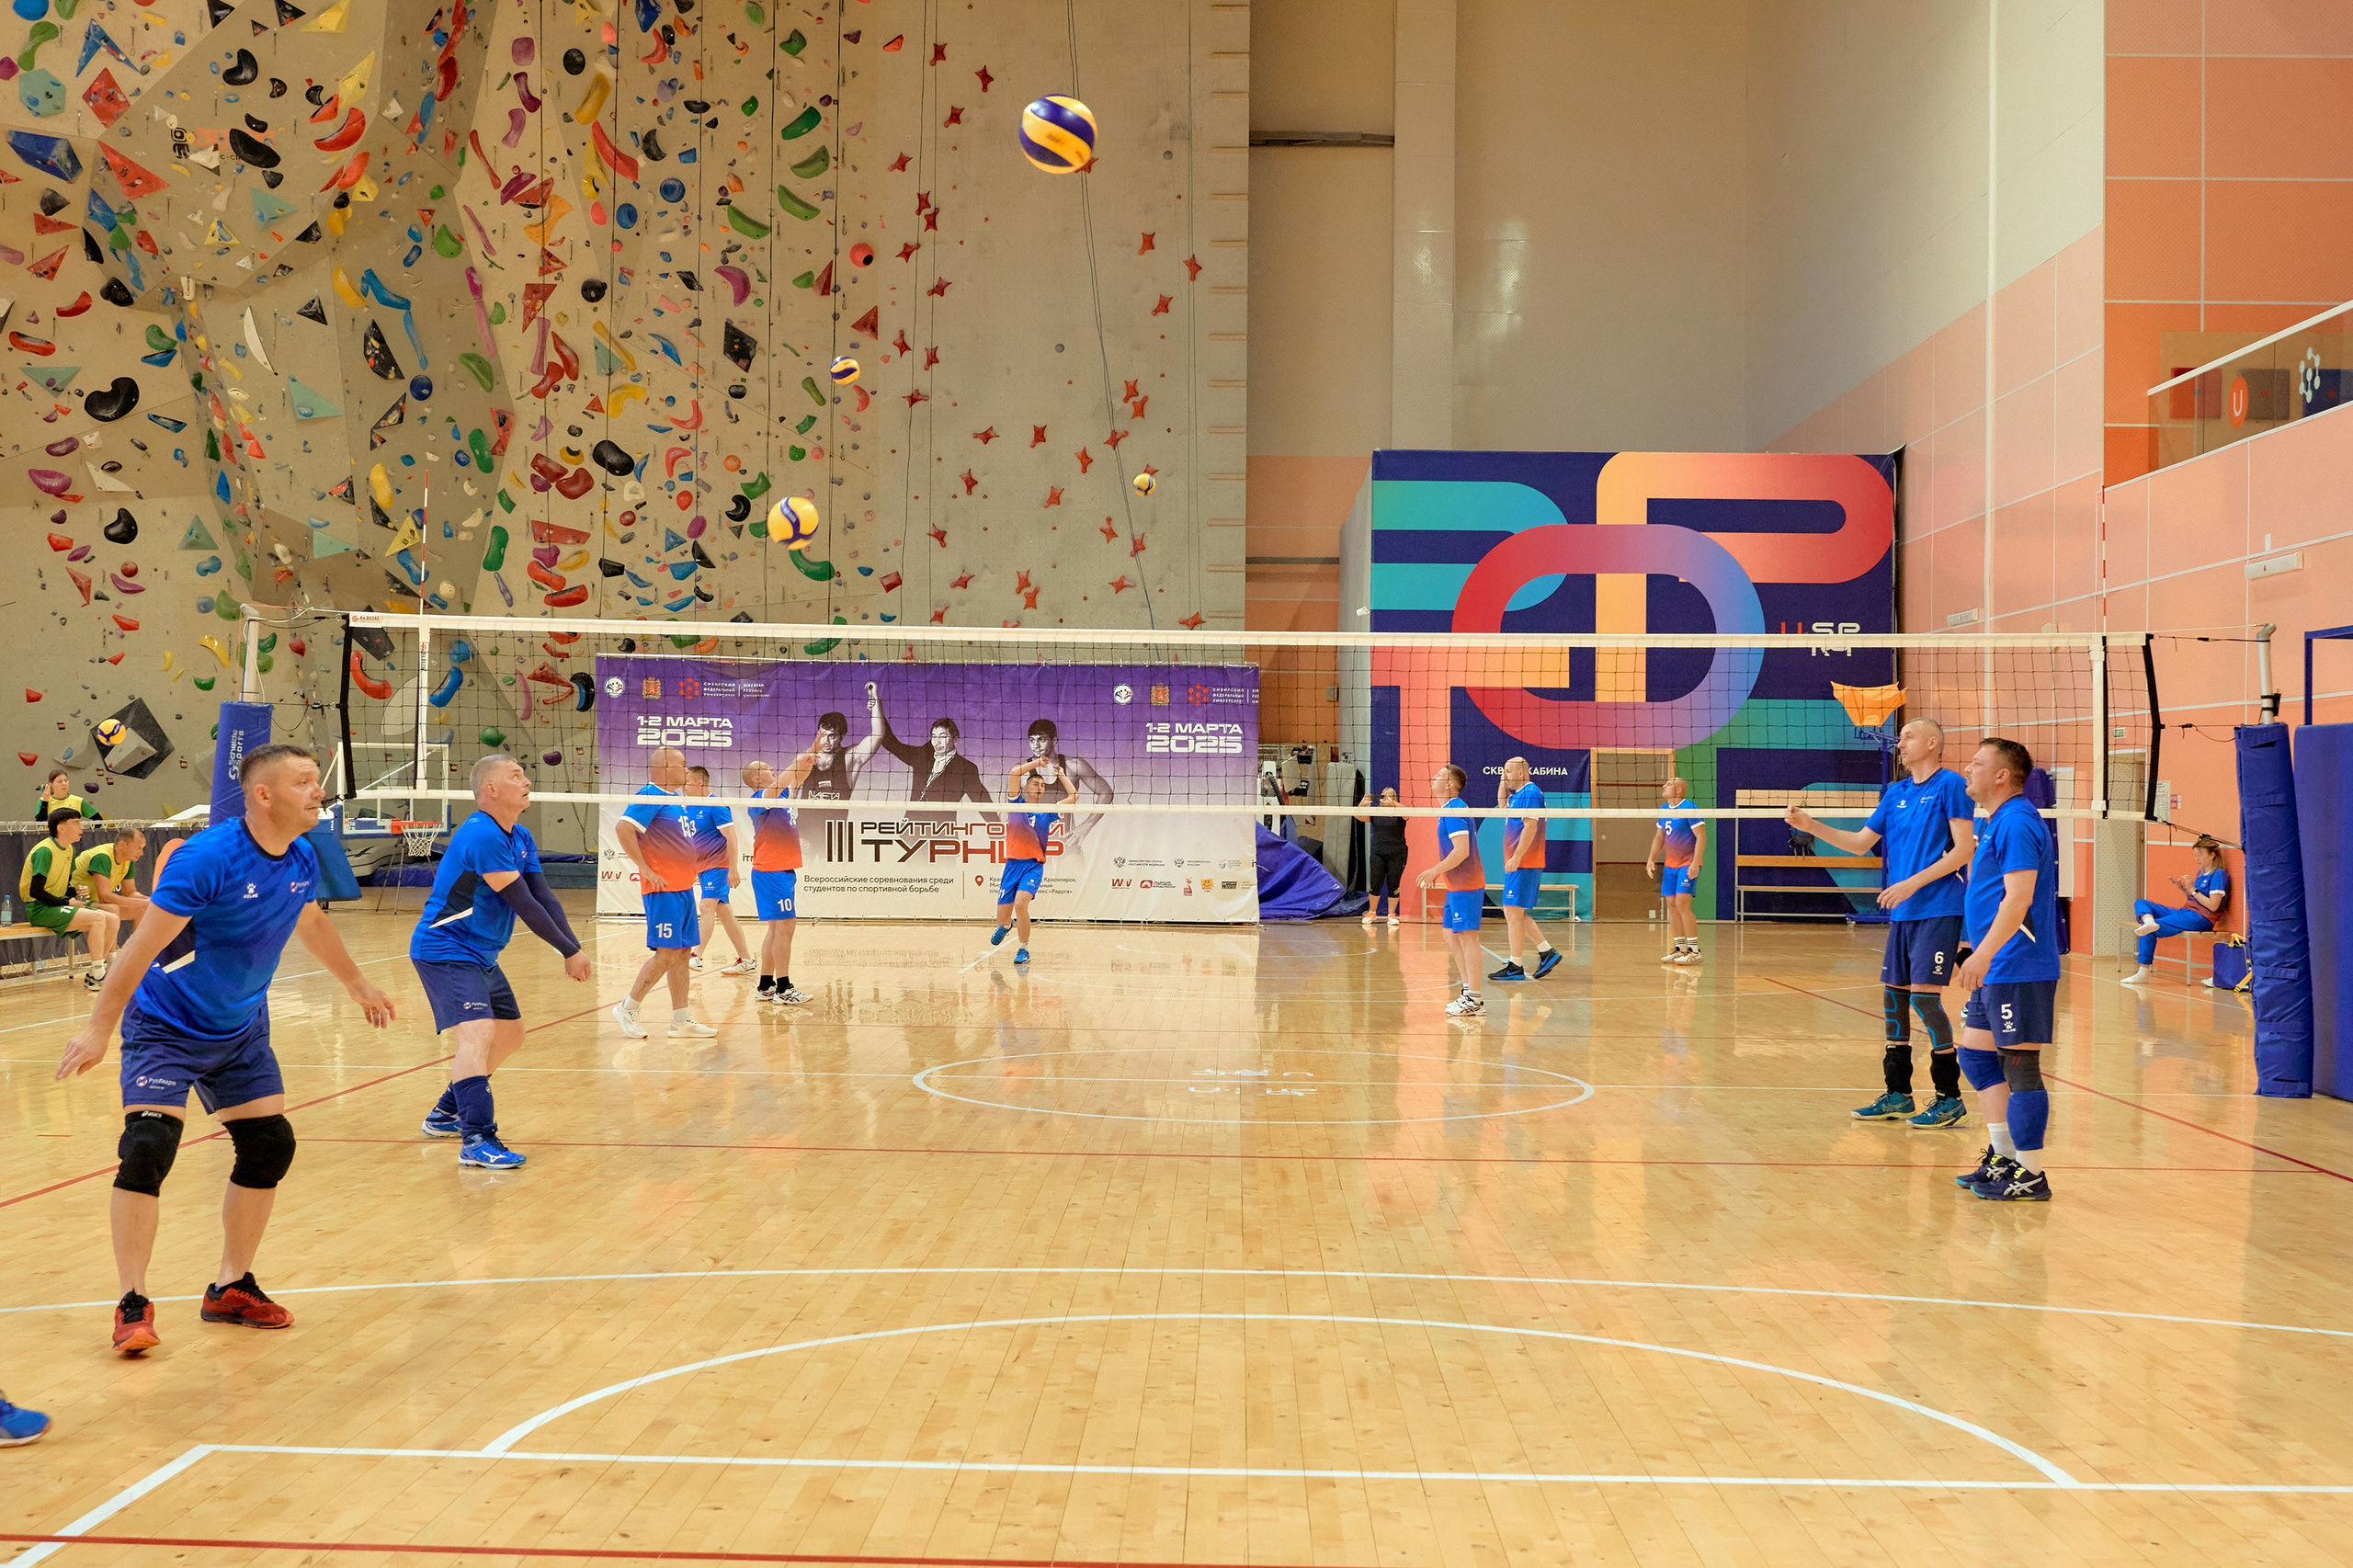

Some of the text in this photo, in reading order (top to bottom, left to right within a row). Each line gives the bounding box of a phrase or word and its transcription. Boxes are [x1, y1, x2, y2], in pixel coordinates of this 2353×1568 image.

[636, 715, 733, 728] 1-2 МАРТА
[1145, 722, 1243, 733] 1-2 МАРТА
[637, 728, 733, 747] 2025
[1146, 734, 1243, 754] 2025
[860, 817, 1064, 836] РЕЙТИНГОЙ
[1665, 820, 1672, 835] 5
[804, 874, 868, 883] Всероссийские
[803, 885, 846, 893] студентов
[858, 884, 907, 894] спортивной
[908, 884, 939, 894] борьбе
[777, 898, 792, 912] 10
[655, 923, 673, 938] 15
[1934, 950, 1944, 964] 6
[2000, 1003, 2014, 1019] 5
